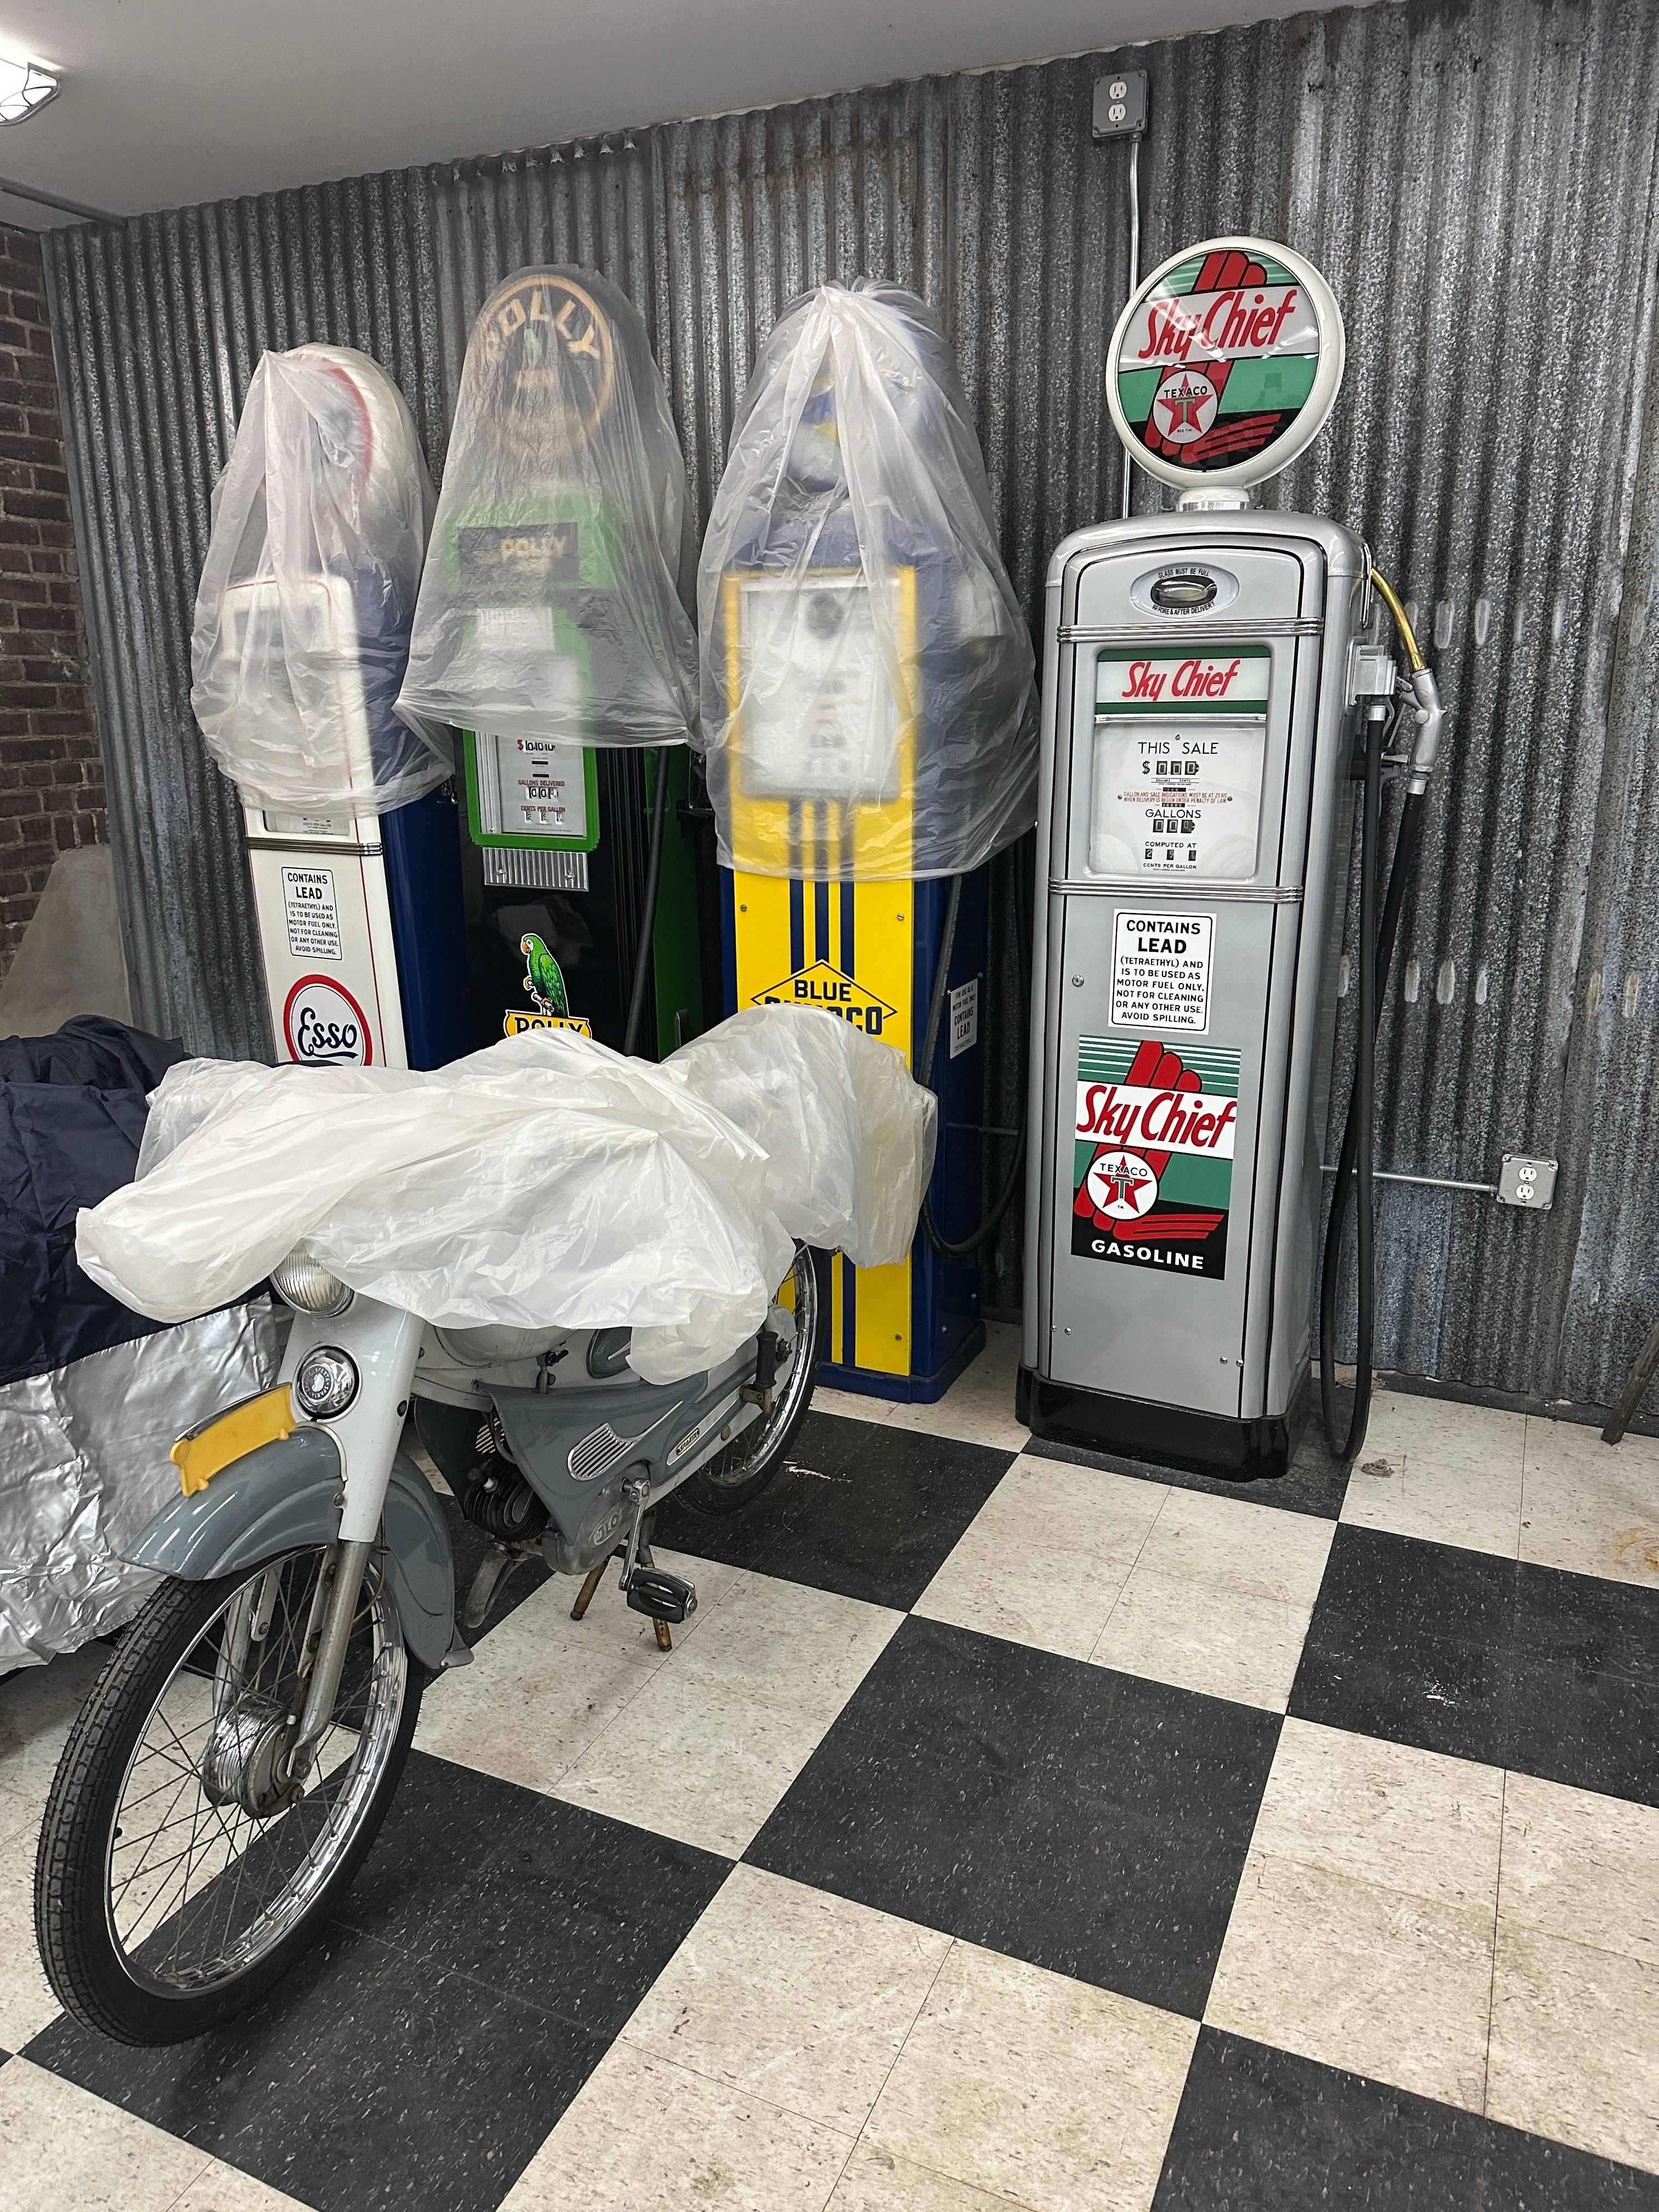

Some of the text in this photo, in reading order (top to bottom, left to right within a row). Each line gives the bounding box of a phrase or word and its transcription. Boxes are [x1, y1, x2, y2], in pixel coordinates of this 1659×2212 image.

[1138, 289, 1297, 361] Sky Chief
[1164, 386, 1208, 399] TEXACO
[1158, 569, 1173, 579] GLASS
[1198, 568, 1210, 577] FULL
[1152, 604, 1170, 615] BEFORE
[1191, 600, 1215, 614] DELIVERY
[1121, 659, 1241, 702] Sky Chief
[1137, 742, 1219, 754] THIS SALE
[1142, 760, 1150, 775] $
[1145, 809, 1201, 819] GALLONS
[287, 872, 328, 884] CONTAINS
[295, 886, 323, 900] LEAD
[288, 901, 320, 911] (TETRAETHYL)
[312, 929, 338, 938] CLEANING
[1126, 919, 1201, 935] CONTAINS
[1138, 937, 1187, 954] LEAD
[1120, 955, 1179, 968] (TETRAETHYL)
[1134, 968, 1145, 977] TO
[1161, 970, 1186, 979] USED
[794, 979, 852, 1002] BLUE
[1116, 979, 1204, 991] MOTOR FUEL ONLY,
[1137, 991, 1155, 999] FOR
[1158, 992, 1204, 1002] CLEANING
[1116, 1000, 1203, 1014] OR ANY OTHER USE.
[954, 1006, 974, 1026] CONTAINS
[1121, 1012, 1196, 1024] AVOID SPILLING.
[298, 1007, 359, 1059] Esso
[957, 1021, 970, 1040] LEAD
[1075, 1085, 1238, 1148] Sky Chief
[1100, 1163, 1148, 1177] TEXACO
[1091, 1239, 1204, 1270] GASOLINE
